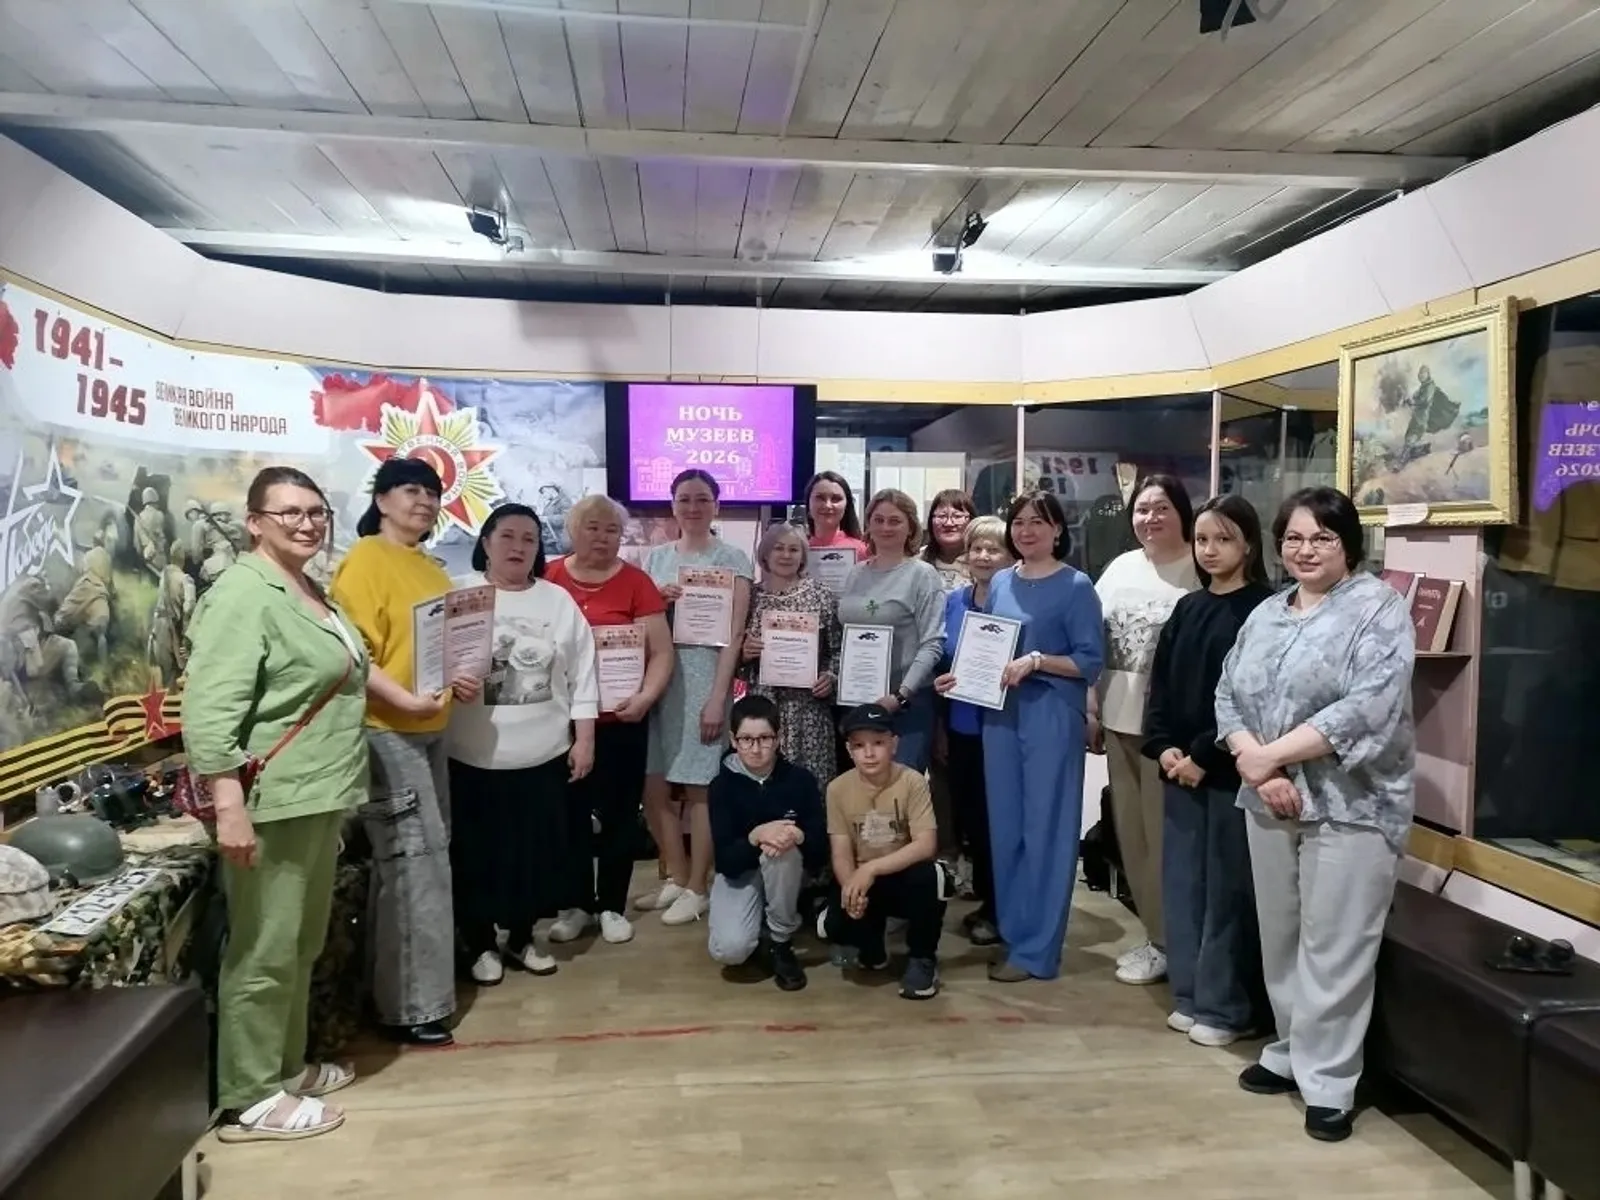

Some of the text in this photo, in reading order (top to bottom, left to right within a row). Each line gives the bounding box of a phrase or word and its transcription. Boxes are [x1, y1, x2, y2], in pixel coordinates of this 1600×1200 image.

[77, 373, 146, 426] 1945
[155, 380, 234, 411] ВЕЛИКАЯ ВОЙНА
[174, 406, 287, 436] ВЕЛИКОГО НАРОДА
[678, 405, 743, 421] НОЧЬ
[666, 427, 755, 443] МУЗЕЕВ
[685, 450, 741, 465] 2026
